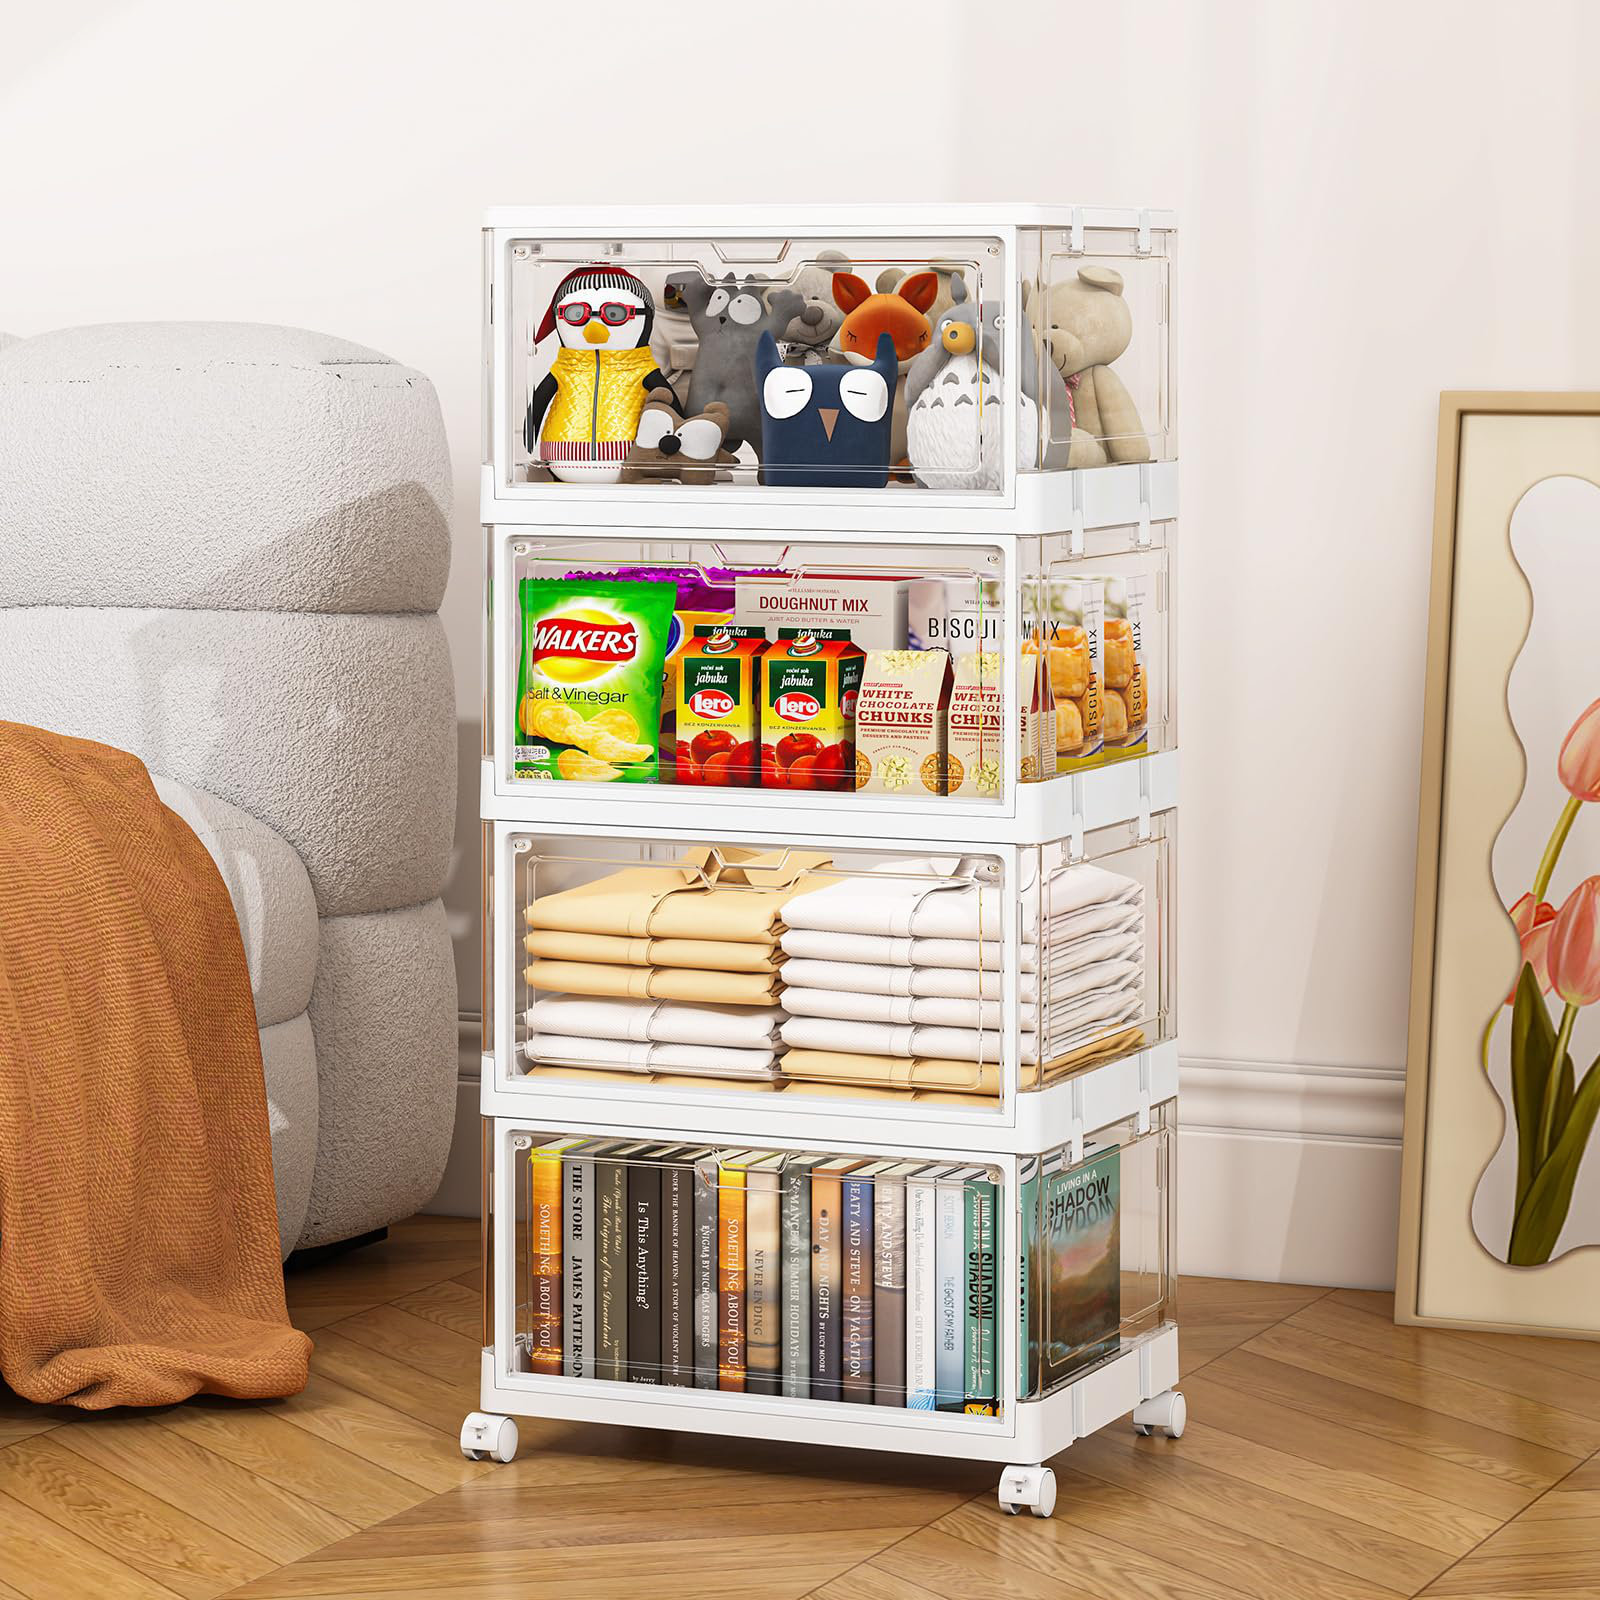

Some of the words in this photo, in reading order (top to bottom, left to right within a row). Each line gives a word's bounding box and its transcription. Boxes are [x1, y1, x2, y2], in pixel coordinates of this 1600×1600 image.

[759, 596, 838, 612] DOUGHNUT
[842, 599, 869, 613] MIX
[533, 625, 639, 654] WALKERS
[1088, 629, 1097, 659] MIX
[1133, 621, 1142, 651] MIX
[694, 671, 728, 687] jabuka
[779, 674, 814, 689] jabuka
[528, 687, 549, 700] Salt
[551, 686, 562, 700] &
[563, 687, 629, 705] Vinegar
[694, 693, 732, 713] Lero
[779, 696, 818, 716] Lero
[859, 700, 934, 711] CHOCOLATE
[862, 689, 913, 700] WHITE
[858, 710, 933, 723] CHUNKS
[572, 1164, 583, 1193] THE
[1056, 1176, 1081, 1195] LIVING
[1081, 1173, 1090, 1185] IN
[1090, 1169, 1098, 1180] A
[601, 1195, 612, 1214] The
[637, 1201, 649, 1213] Is
[1045, 1175, 1111, 1219] SHADOW
[572, 1196, 583, 1241] STORE
[637, 1217, 649, 1244] This
[819, 1216, 830, 1242] DAY
[850, 1220, 861, 1245] AND
[539, 1203, 551, 1273] SOMETHING
[601, 1217, 612, 1254] Origins
[672, 1239, 679, 1249] OF
[701, 1225, 710, 1259] ENIGMA
[882, 1222, 892, 1249] AND
[601, 1256, 612, 1268] of
[701, 1260, 710, 1270] BY
[727, 1218, 739, 1290] SOMETHING
[753, 1249, 764, 1285] NEVER
[850, 1249, 861, 1285] STEVE
[572, 1255, 583, 1300] JAMES
[601, 1268, 612, 1288] Our
[635, 1249, 650, 1310] Anything?
[790, 1257, 801, 1301] SUMMER
[882, 1252, 892, 1288] STEVE
[539, 1277, 551, 1318] ABOUT
[701, 1271, 710, 1313] NICHOLAS
[819, 1274, 830, 1319] NIGHTS
[850, 1295, 861, 1313] ON
[943, 1288, 954, 1309] GHOST
[601, 1290, 612, 1349] Discontents
[672, 1311, 679, 1322] OF
[727, 1294, 739, 1335] ABOUT
[753, 1289, 764, 1336] ENDING
[819, 1322, 826, 1331] BY
[943, 1309, 954, 1318] OF
[943, 1318, 954, 1328] MY
[539, 1319, 551, 1348] YOU
[701, 1315, 710, 1347] ROGERS
[790, 1303, 801, 1357] HOLIDAYS
[943, 1328, 954, 1351] FATHER
[727, 1336, 739, 1365] YOU
[850, 1316, 861, 1378] VACATION
